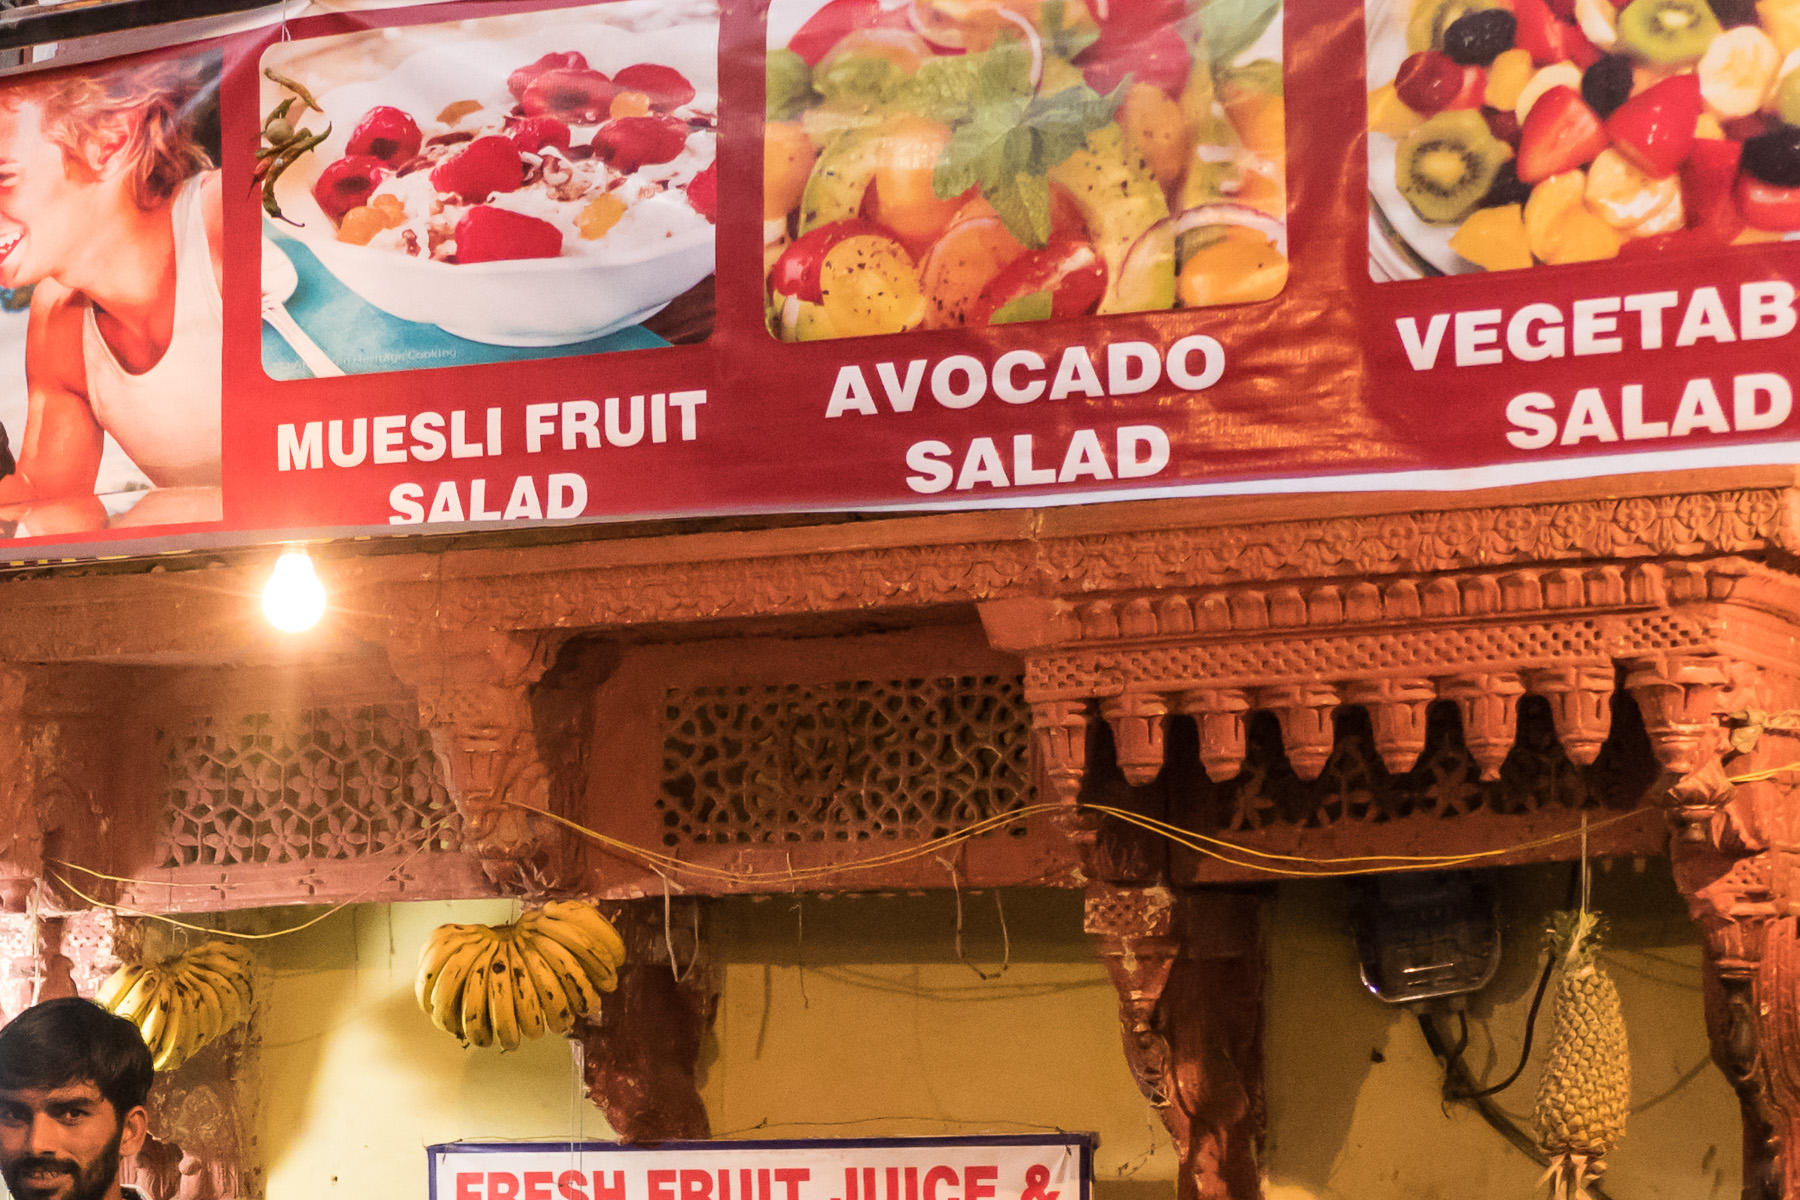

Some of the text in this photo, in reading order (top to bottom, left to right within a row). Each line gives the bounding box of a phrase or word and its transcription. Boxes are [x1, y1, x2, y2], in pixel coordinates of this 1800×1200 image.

[1396, 280, 1796, 370] VEGETAB
[825, 334, 1225, 419] AVOCADO
[1505, 373, 1793, 450] SALAD
[277, 389, 707, 473] MUESLI FRUIT
[905, 425, 1170, 494] SALAD
[388, 473, 588, 526] SALAD
